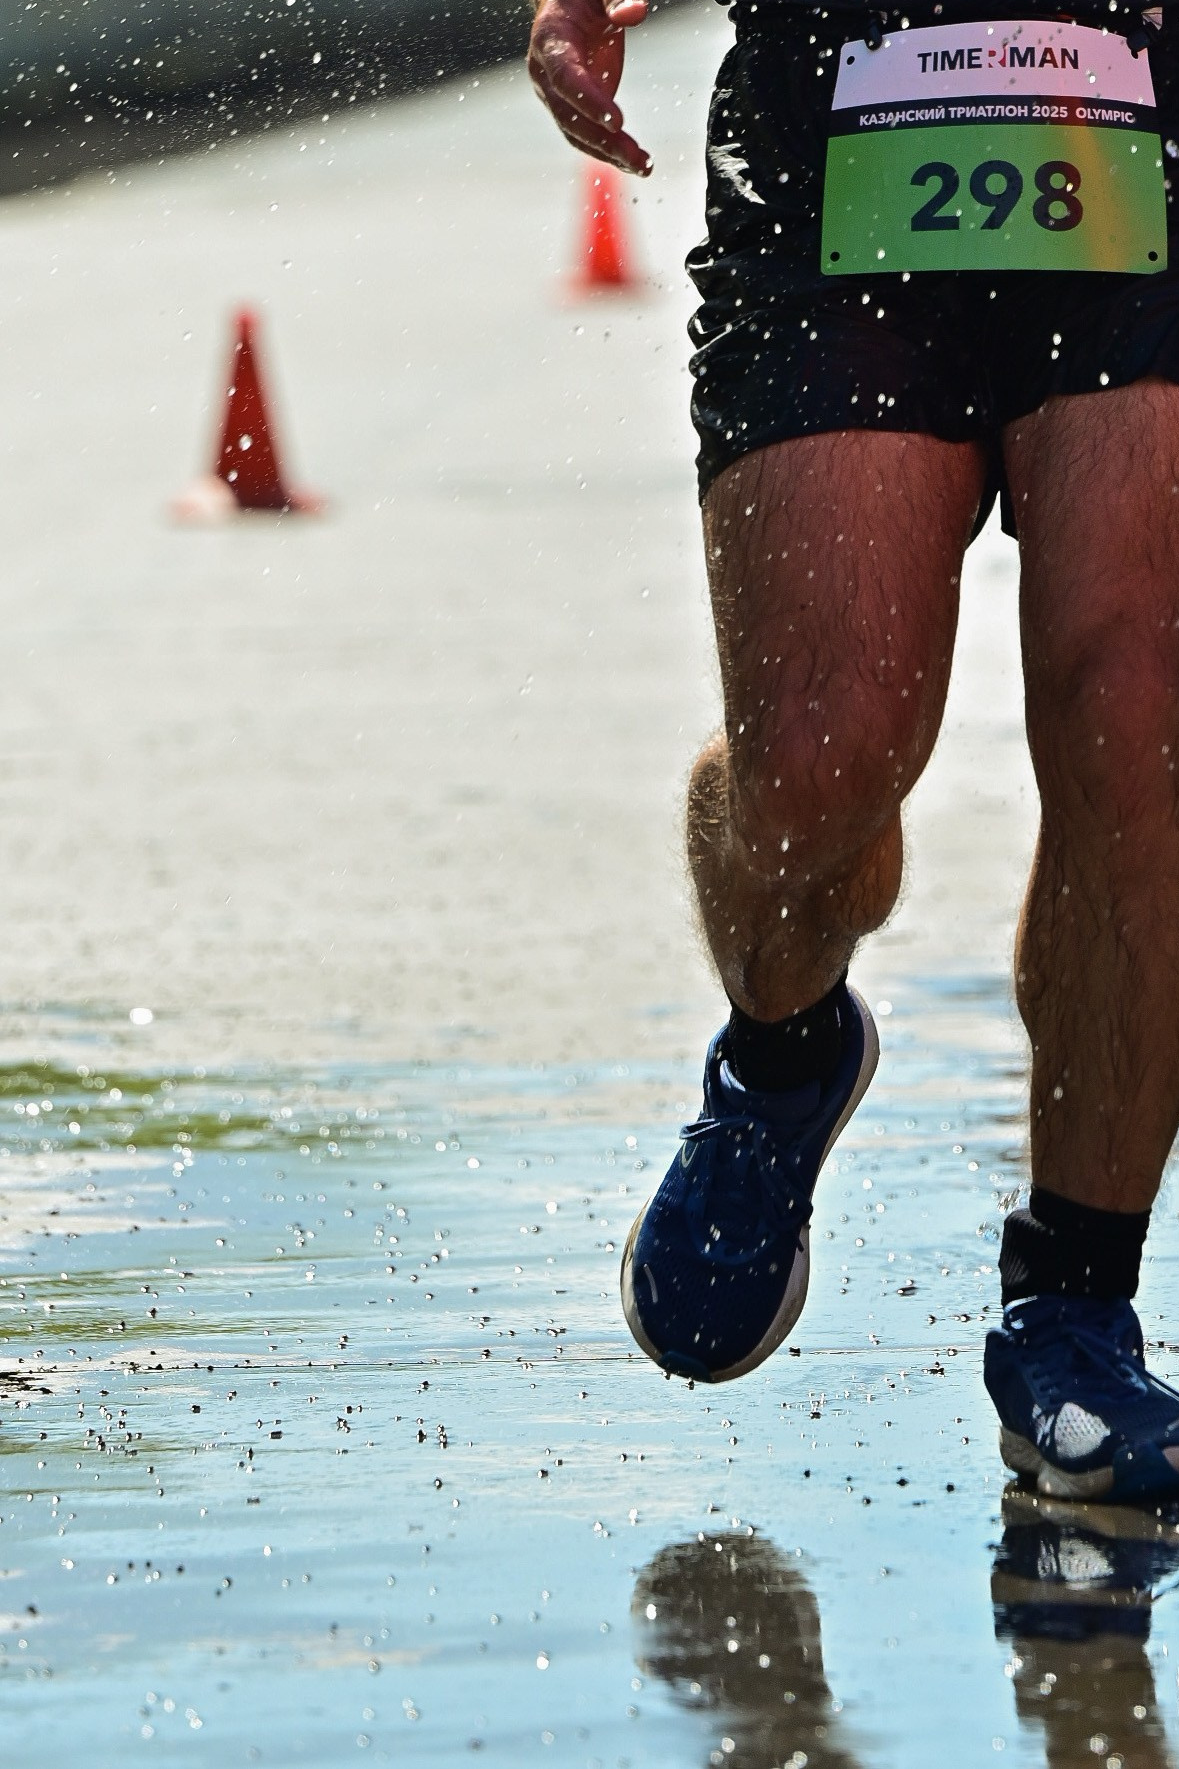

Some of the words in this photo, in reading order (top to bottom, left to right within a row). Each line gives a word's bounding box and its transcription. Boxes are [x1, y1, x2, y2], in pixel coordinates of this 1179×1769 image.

[859, 105, 945, 127] КАЗАНСКИЙ
[948, 105, 1028, 119] ТРИАТЛОН
[1032, 105, 1068, 118] 2025
[1075, 107, 1136, 124] OLYMPIC
[910, 160, 1084, 232] 298
